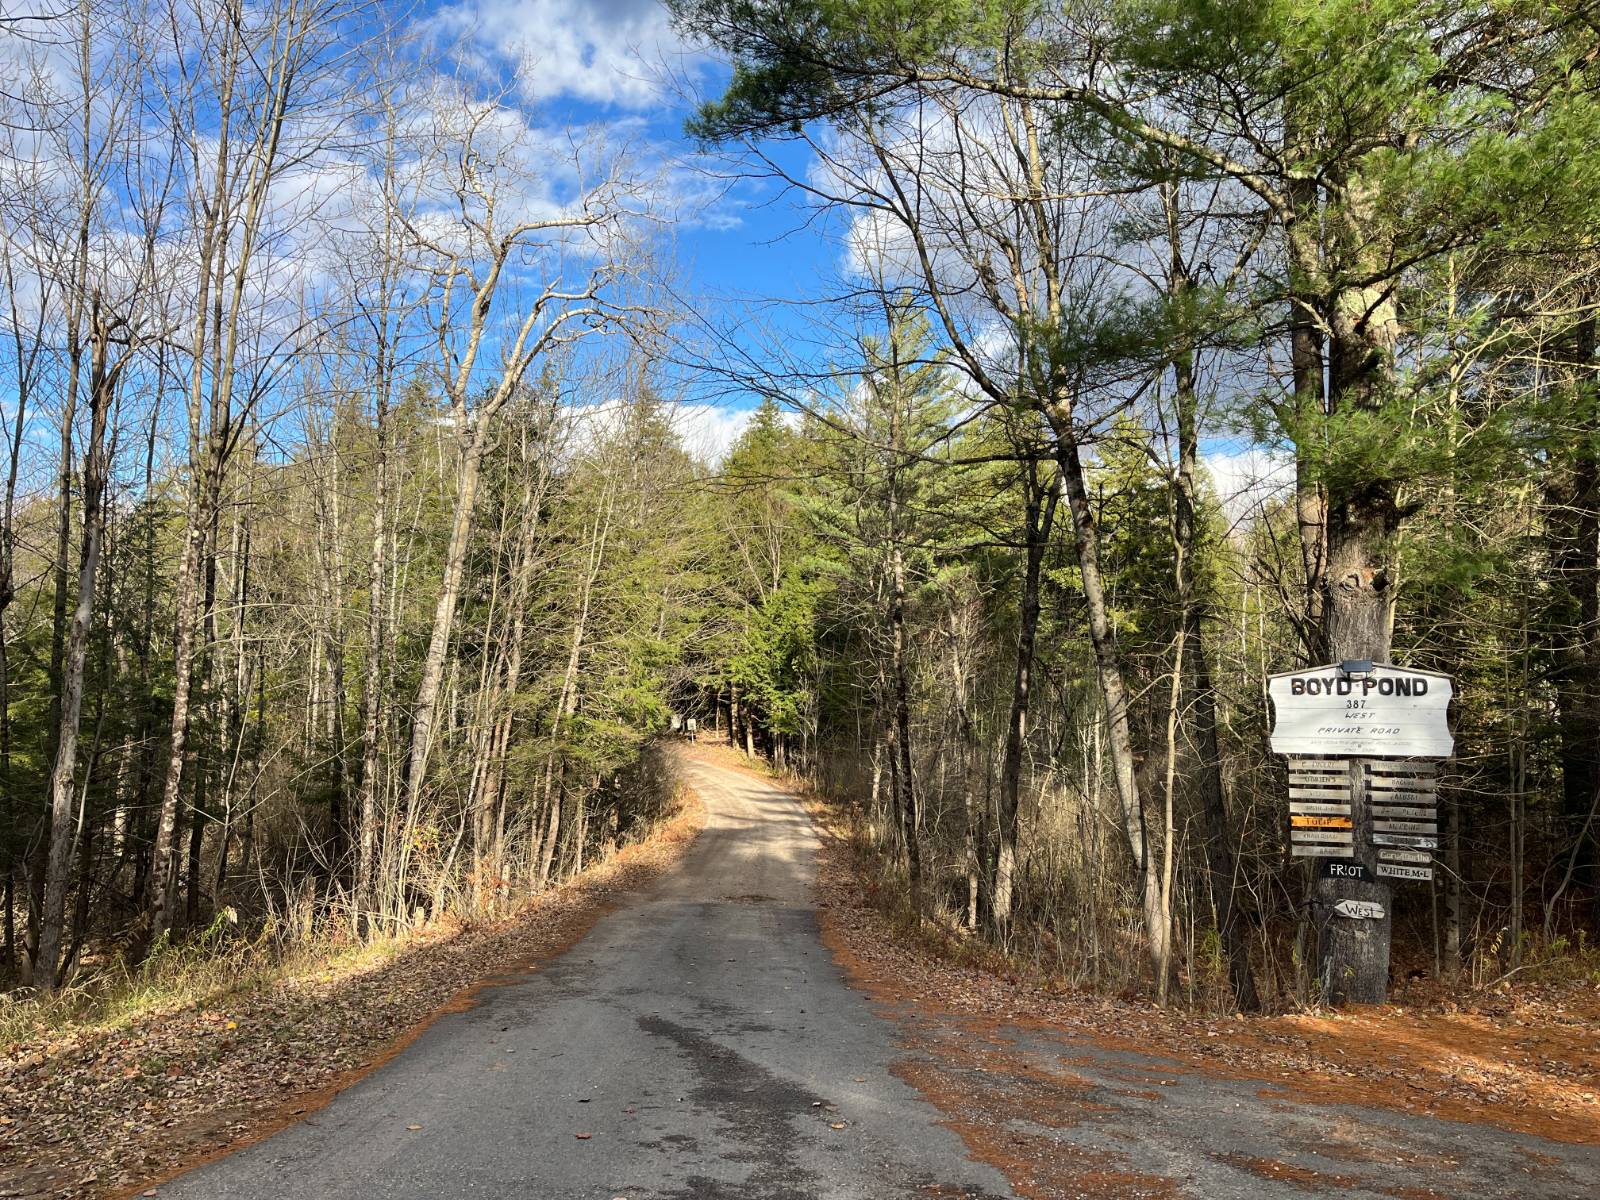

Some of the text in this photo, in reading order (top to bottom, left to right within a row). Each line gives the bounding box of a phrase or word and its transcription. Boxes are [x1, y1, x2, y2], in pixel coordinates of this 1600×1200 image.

[1291, 678, 1428, 697] BOYD POND
[1346, 700, 1367, 709] 387
[1317, 726, 1364, 735] PRIVATE
